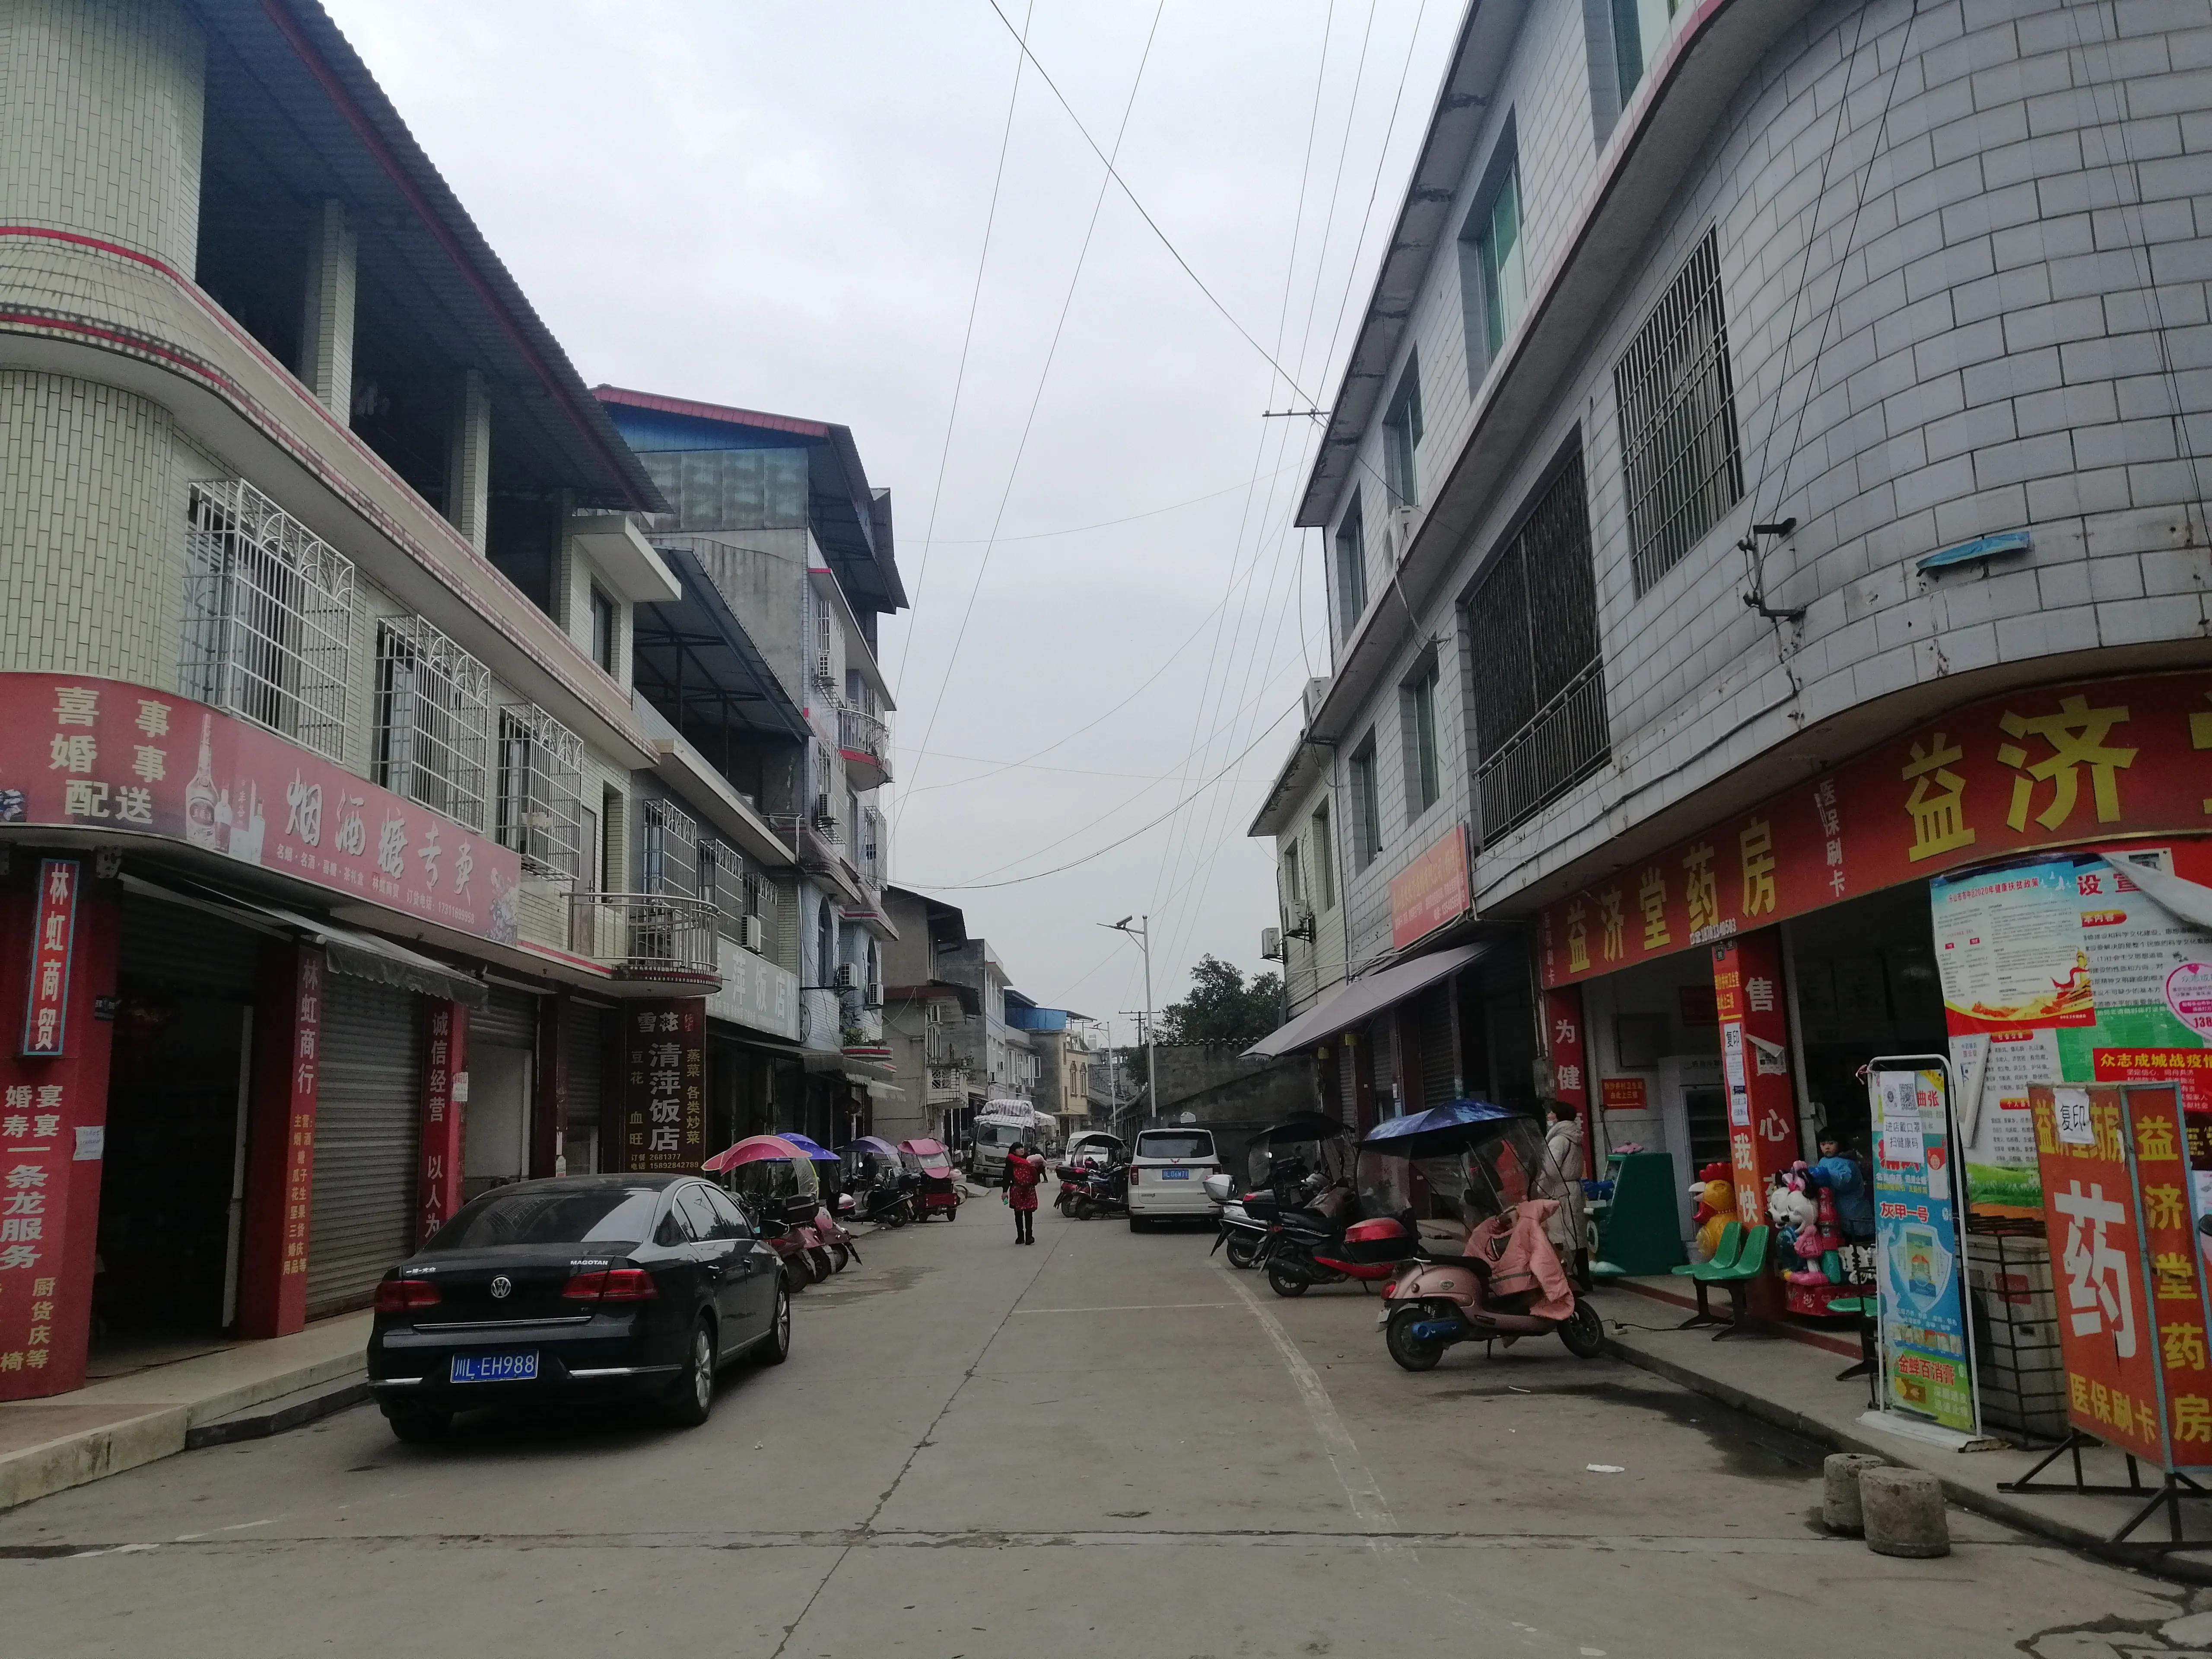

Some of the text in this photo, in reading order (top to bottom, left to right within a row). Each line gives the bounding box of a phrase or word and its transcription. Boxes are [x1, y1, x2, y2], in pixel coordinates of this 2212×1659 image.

[52, 686, 172, 737] 喜事
[48, 733, 167, 783] 婚事
[1902, 691, 2212, 863] 益济
[64, 779, 153, 824] 配送
[286, 767, 474, 906] 烟酒糖专卖
[1819, 778, 1845, 897] 医保刷卡
[1567, 817, 1776, 973] 益济堂药房
[35, 863, 69, 1051] 林虹商贸
[298, 958, 318, 1094] 林虹商行
[637, 1012, 679, 1033] 雪花
[1726, 1030, 1740, 1048] 复印
[429, 1011, 448, 1122] 诚信经营
[630, 1051, 644, 1085] 豆花
[686, 1049, 700, 1077] 蒸菜
[5, 1085, 63, 1108] 婚宴
[648, 1042, 682, 1151] 清萍饭店
[686, 1085, 700, 1144] 各类炒菜
[2060, 1104, 2086, 1132] 复印
[2, 1113, 60, 1138] 寿宴
[629, 1111, 644, 1145] 血旺
[1889, 1137, 1919, 1149] 扫健康码
[291, 1186, 307, 1201] 花生
[292, 1168, 308, 1182] 瓜子
[0, 1147, 51, 1270] 一条龙服务
[1880, 1201, 1929, 1224] 灰甲一号
[283, 1259, 307, 1276] 用品等
[2054, 1179, 2136, 1358] 药
[2136, 1115, 2212, 1443] 益济堂药房
[2070, 1371, 2156, 1444] 医保刷卡
